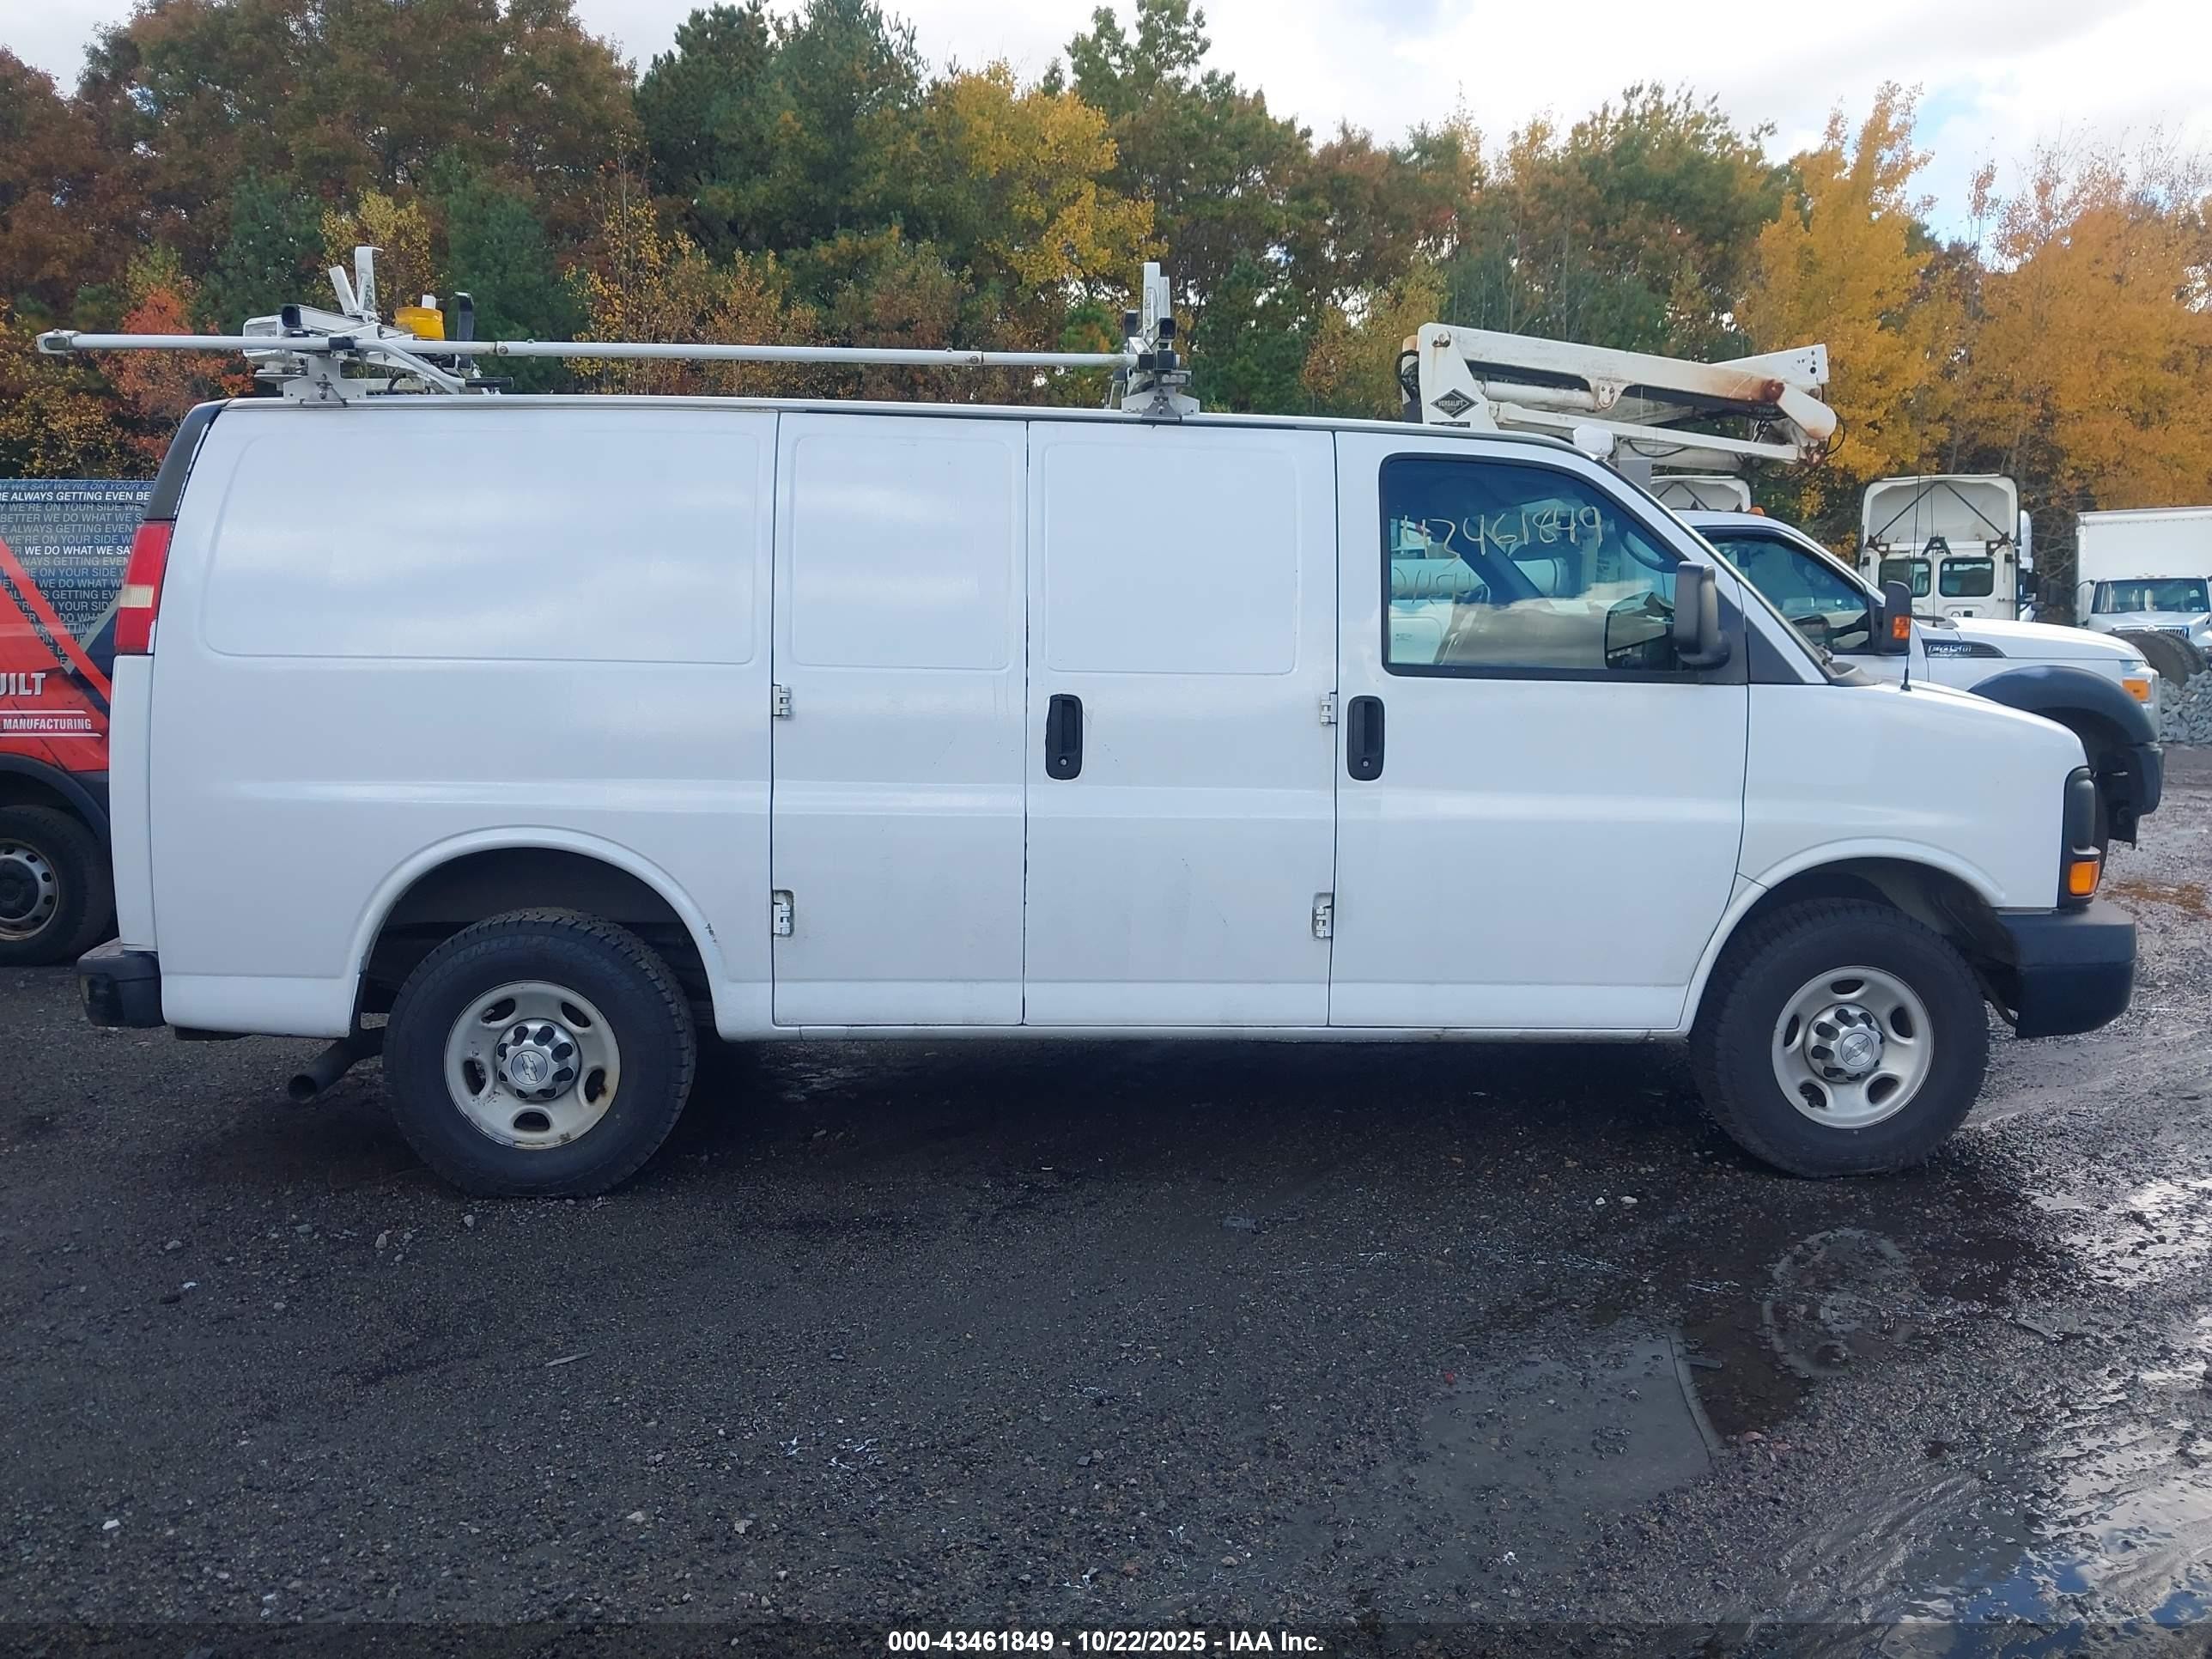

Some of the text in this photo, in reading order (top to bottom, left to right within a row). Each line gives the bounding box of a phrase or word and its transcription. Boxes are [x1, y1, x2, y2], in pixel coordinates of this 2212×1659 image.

[11, 492, 53, 501] ALWAYS
[56, 492, 102, 501] GETTING
[106, 492, 133, 501] EVEN
[9, 503, 41, 512] WE'RE
[46, 503, 60, 512] ON
[64, 503, 94, 512] YOUR
[97, 503, 123, 512] SIDE
[0, 514, 40, 522] BETTER
[43, 514, 61, 522] WE
[63, 514, 78, 522] DO
[82, 514, 111, 522] WHAT
[115, 514, 133, 522] WE
[10, 525, 52, 533] ALWAYS
[56, 525, 101, 533] GETTING
[105, 525, 132, 533] EVEN
[5, 535, 39, 544] WE'RE
[42, 535, 57, 544] ON
[60, 535, 90, 544] YOUR
[94, 535, 118, 544] SIDE
[25, 546, 41, 555] WE
[44, 546, 60, 555] DO
[63, 546, 94, 555] WHAT
[96, 546, 113, 555] WE
[53, 557, 99, 566] GETTING
[40, 568, 55, 577] ON
[58, 568, 88, 577] YOUR
[92, 568, 117, 577] SIDE
[39, 579, 55, 588] WE
[58, 579, 74, 588] DO
[77, 579, 107, 588] WHAT
[52, 590, 99, 599] GETTING
[58, 602, 88, 611] YOUR
[58, 613, 74, 623] DO
[3, 719, 92, 729] MANUFACTURING
